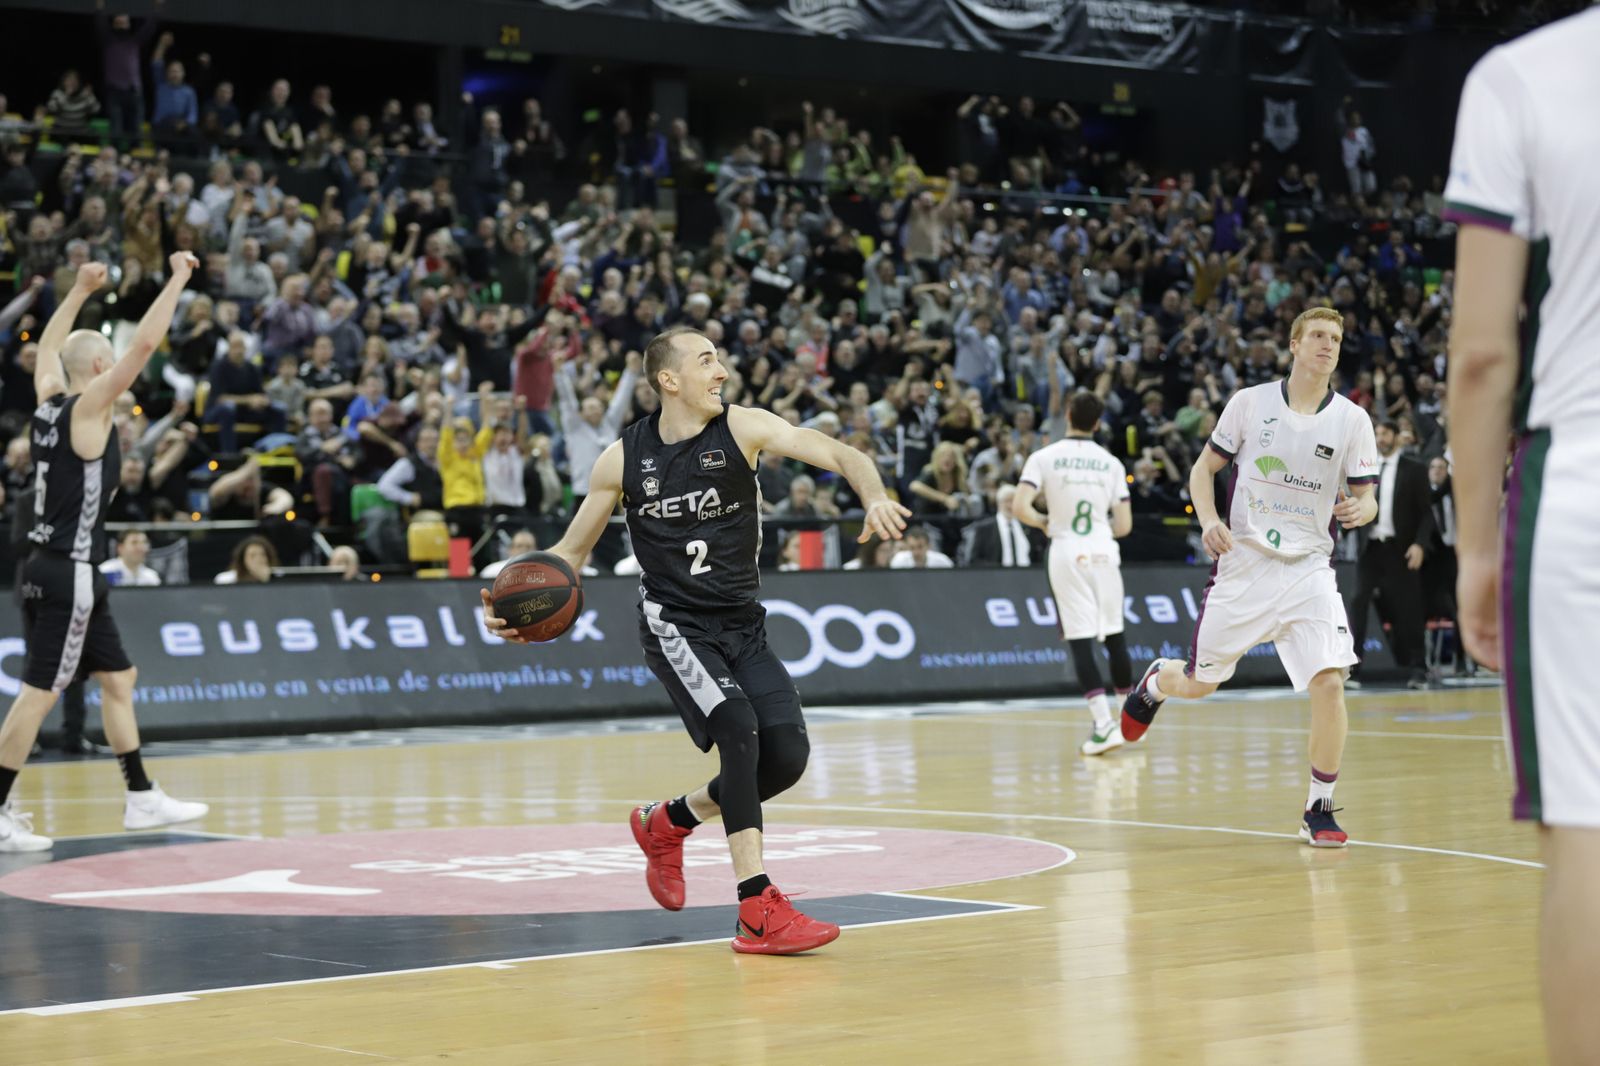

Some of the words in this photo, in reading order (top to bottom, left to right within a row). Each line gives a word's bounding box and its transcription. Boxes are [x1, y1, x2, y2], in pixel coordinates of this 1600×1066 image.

[1283, 473, 1322, 494] Unicaja
[638, 487, 721, 520] RETA
[1071, 499, 1092, 536] 8
[1266, 528, 1281, 550] 9
[686, 539, 712, 576] 2
[274, 679, 308, 697] en
[317, 671, 391, 694] venta
[397, 669, 430, 692] de
[579, 667, 595, 689] y
